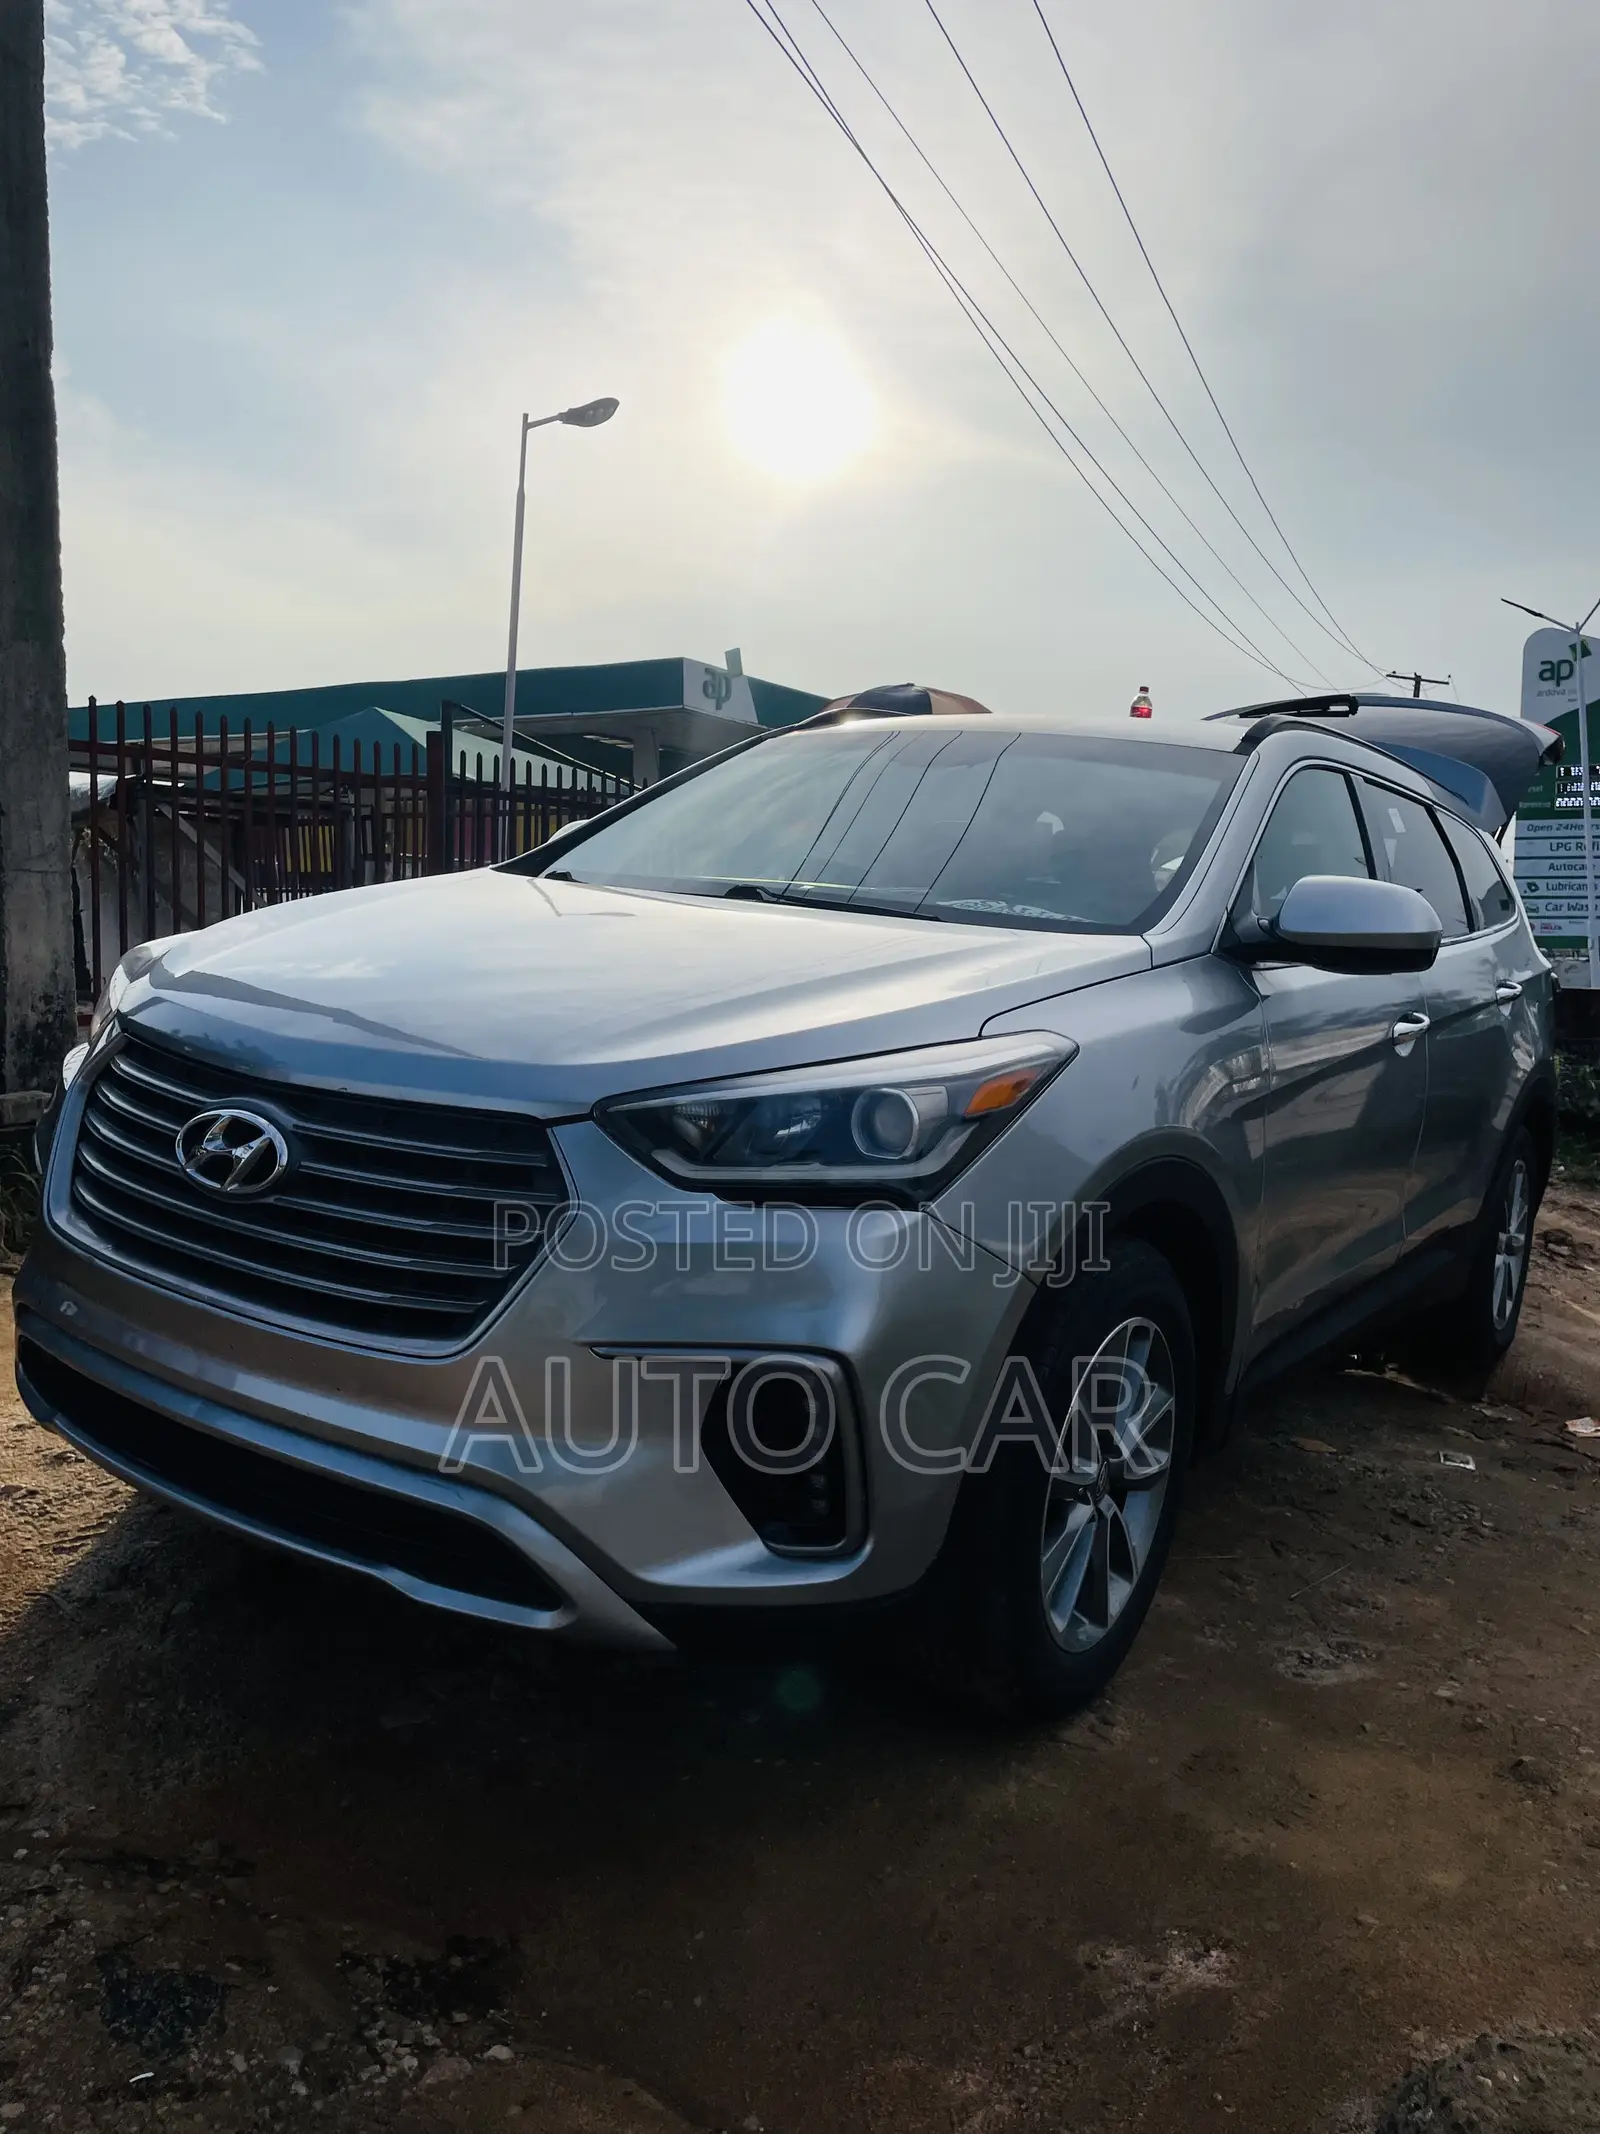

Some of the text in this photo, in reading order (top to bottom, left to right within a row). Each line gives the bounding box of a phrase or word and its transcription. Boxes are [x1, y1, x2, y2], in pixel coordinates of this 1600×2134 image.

[1538, 659, 1574, 687] ap
[703, 667, 732, 710] ap
[1537, 688, 1566, 697] ardova
[1526, 822, 1600, 833] Open 24Hors
[1549, 842, 1572, 852] LPG
[1546, 881, 1598, 892] Lubricans
[1545, 902, 1564, 912] Car
